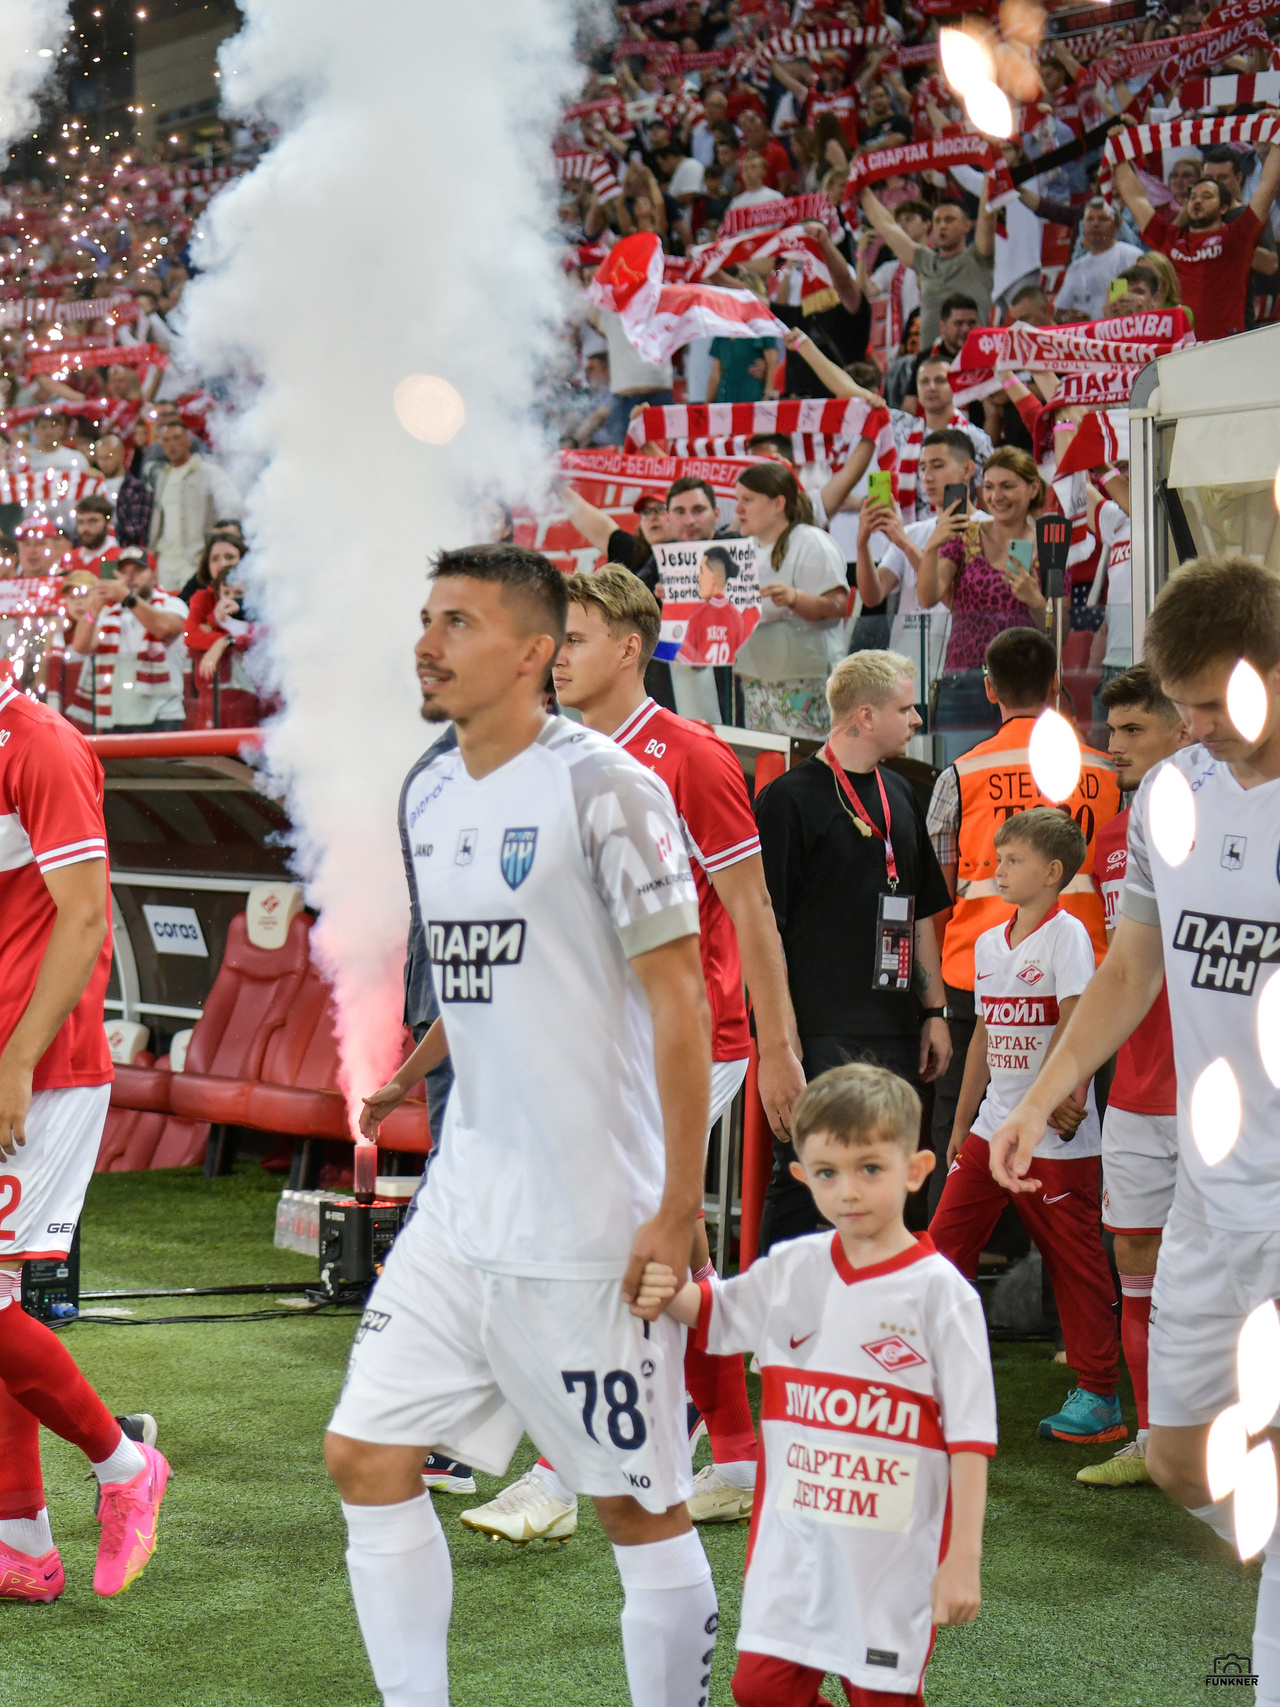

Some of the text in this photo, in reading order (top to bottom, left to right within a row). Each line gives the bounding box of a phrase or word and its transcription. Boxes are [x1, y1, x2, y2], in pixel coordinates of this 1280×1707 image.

[1219, 3, 1245, 24] FC
[869, 143, 929, 169] СПАРТАК
[1094, 314, 1173, 341] МОСКВА
[1036, 333, 1158, 364] SPARTAK
[1044, 361, 1091, 370] YOU'LL
[661, 548, 697, 566] Jesus
[644, 738, 666, 758] BQ
[989, 772, 1099, 801] STERD
[430, 922, 523, 962] ПАРИ
[445, 964, 491, 1000] НН
[1197, 954, 1257, 991] НН
[982, 998, 1046, 1024] УКОЙЛ
[988, 1034, 1043, 1051] АРТАК-
[988, 1053, 1030, 1070] ЕТЯМ
[561, 1369, 647, 1450] 78
[786, 1385, 921, 1440] ЛУКОЙЛ
[786, 1442, 911, 1486] СПАРТАК-
[793, 1479, 878, 1518] ДЕТЯМ
